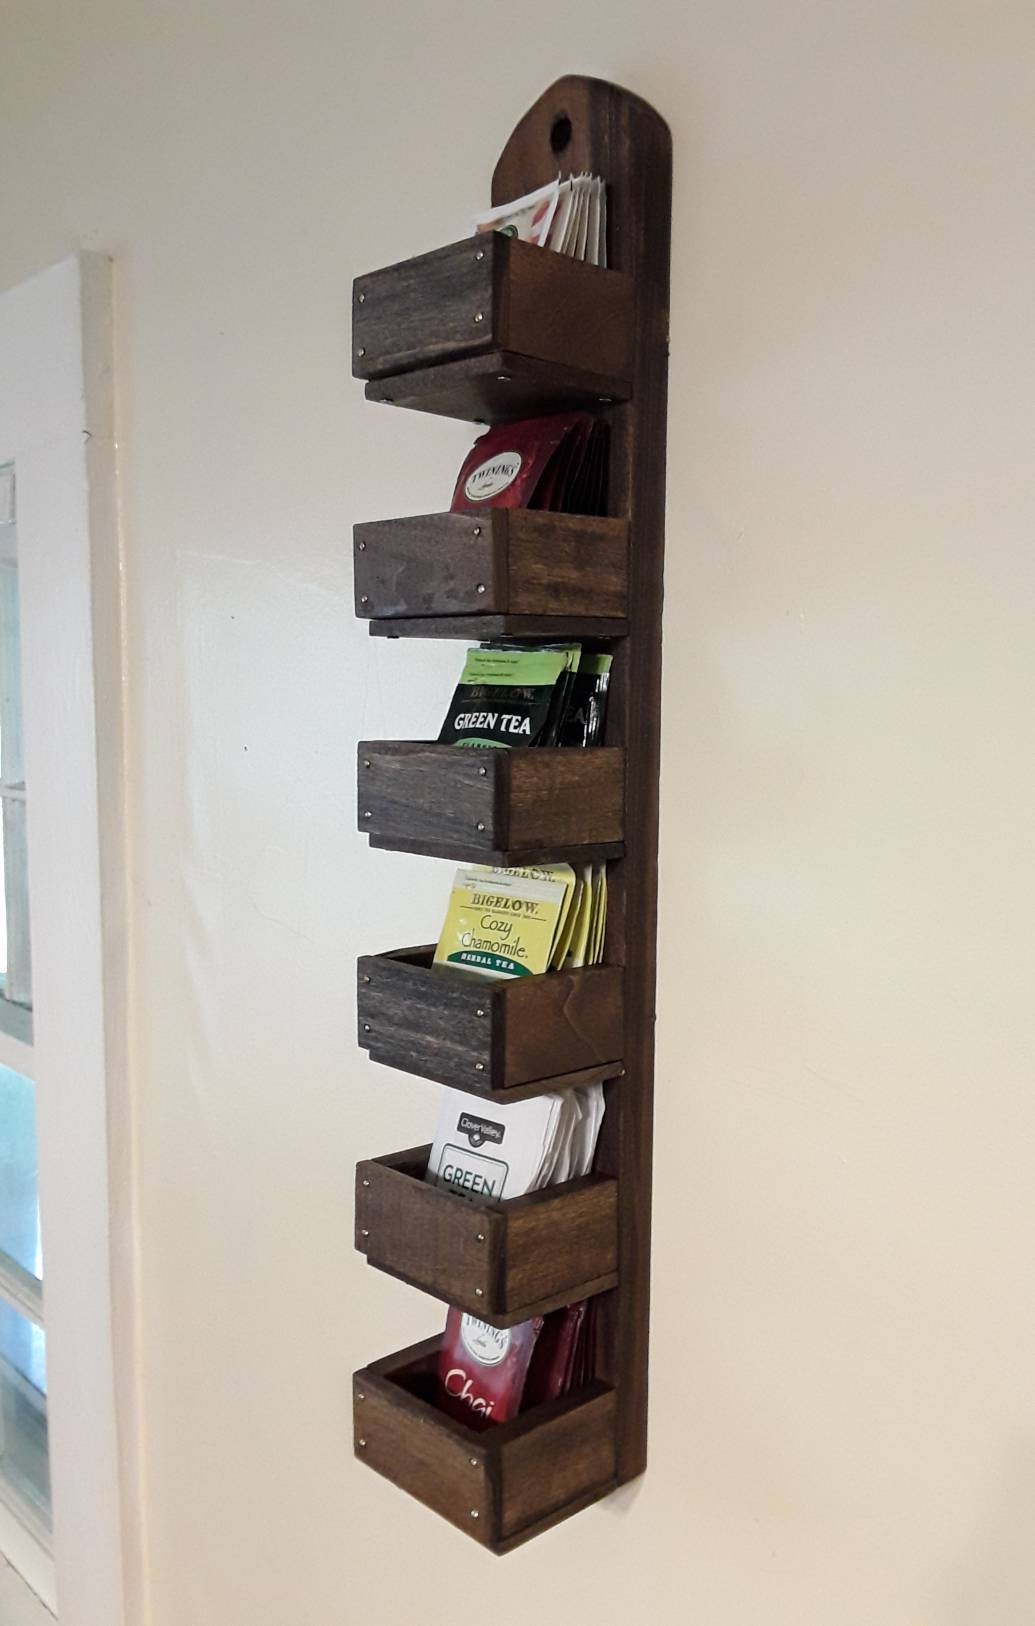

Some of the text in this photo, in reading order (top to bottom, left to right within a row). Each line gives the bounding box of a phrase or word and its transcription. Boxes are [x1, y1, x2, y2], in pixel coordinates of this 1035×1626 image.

[454, 712, 531, 735] GREEN TEA
[480, 914, 513, 940] Cozy
[460, 952, 516, 970] HERBAL TEA
[443, 1164, 497, 1197] GREEN
[444, 1368, 495, 1418] Chai
